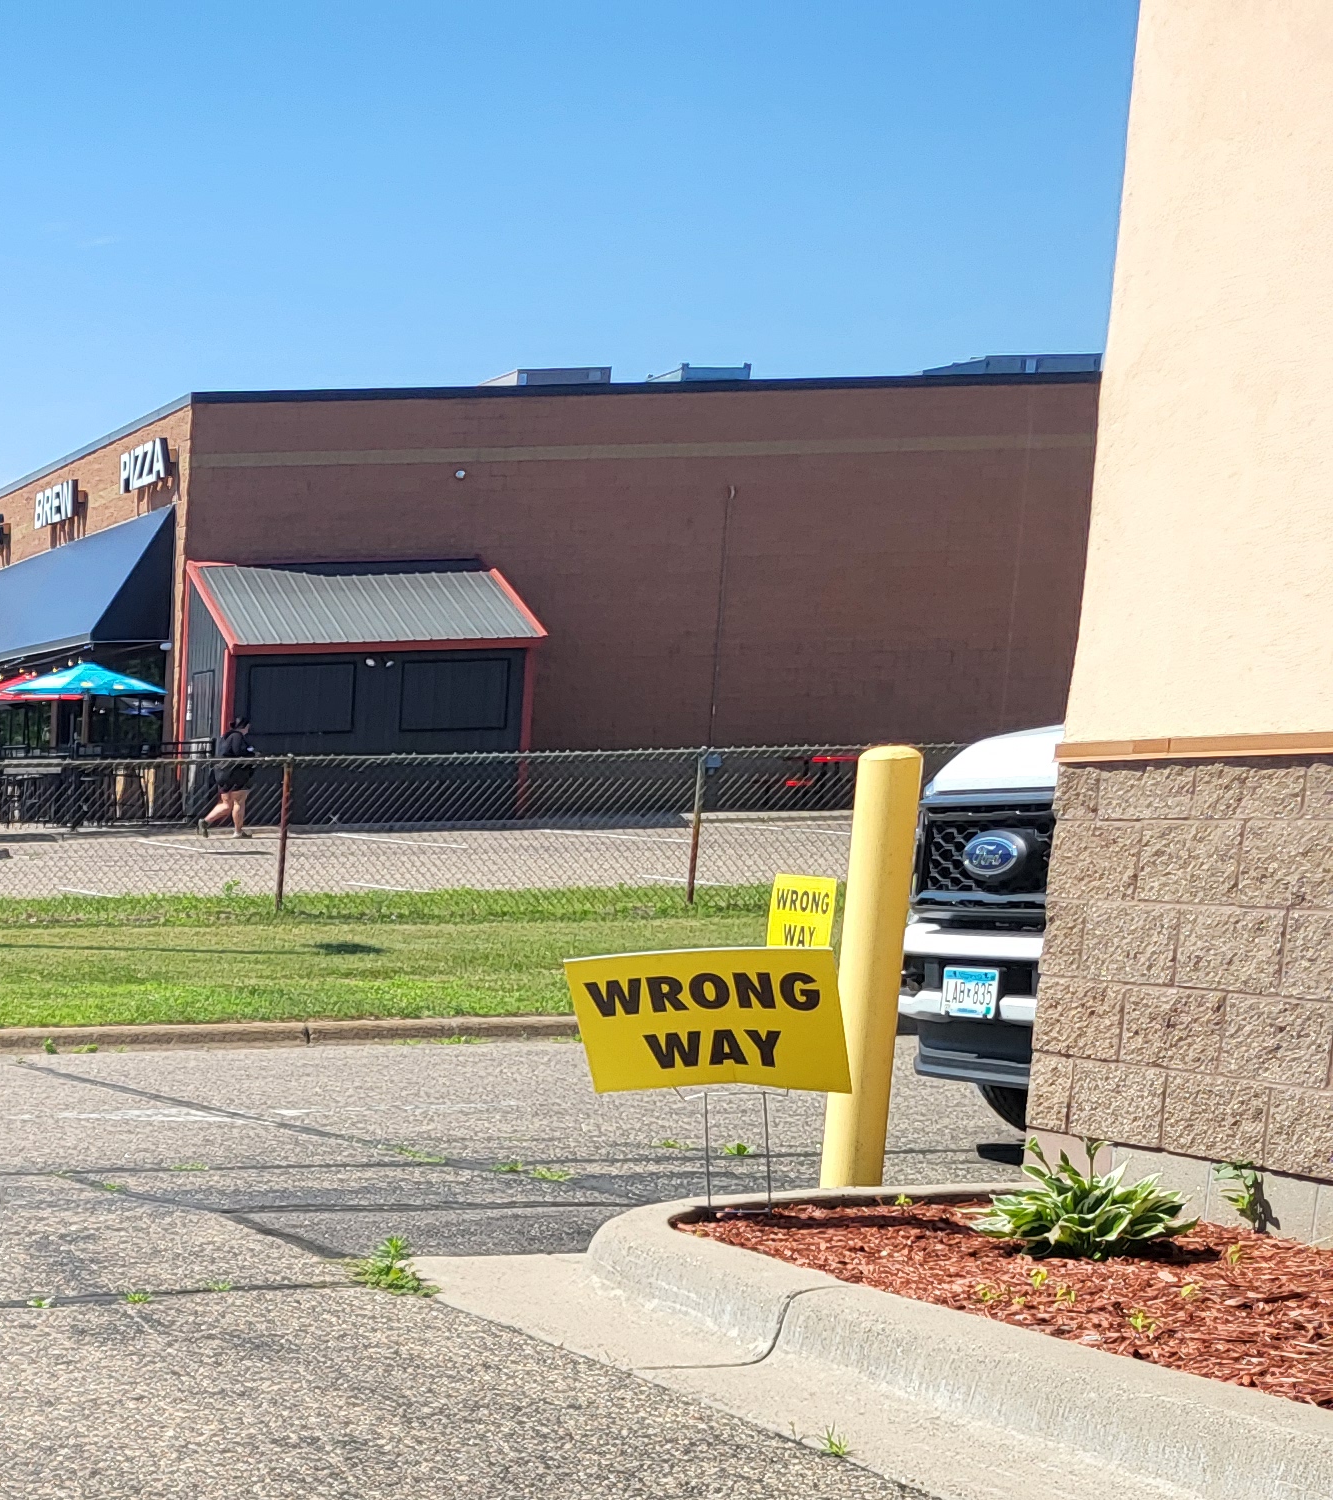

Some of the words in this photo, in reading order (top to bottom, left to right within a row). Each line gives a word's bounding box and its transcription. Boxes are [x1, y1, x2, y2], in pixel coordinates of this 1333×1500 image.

[34, 479, 77, 530] BREW
[119, 437, 167, 495] PIZZA
[972, 844, 1003, 866] Ford
[776, 887, 830, 915] WRONG
[783, 923, 817, 948] WAY
[583, 971, 821, 1018] WRONG
[643, 1029, 782, 1070] WAY
